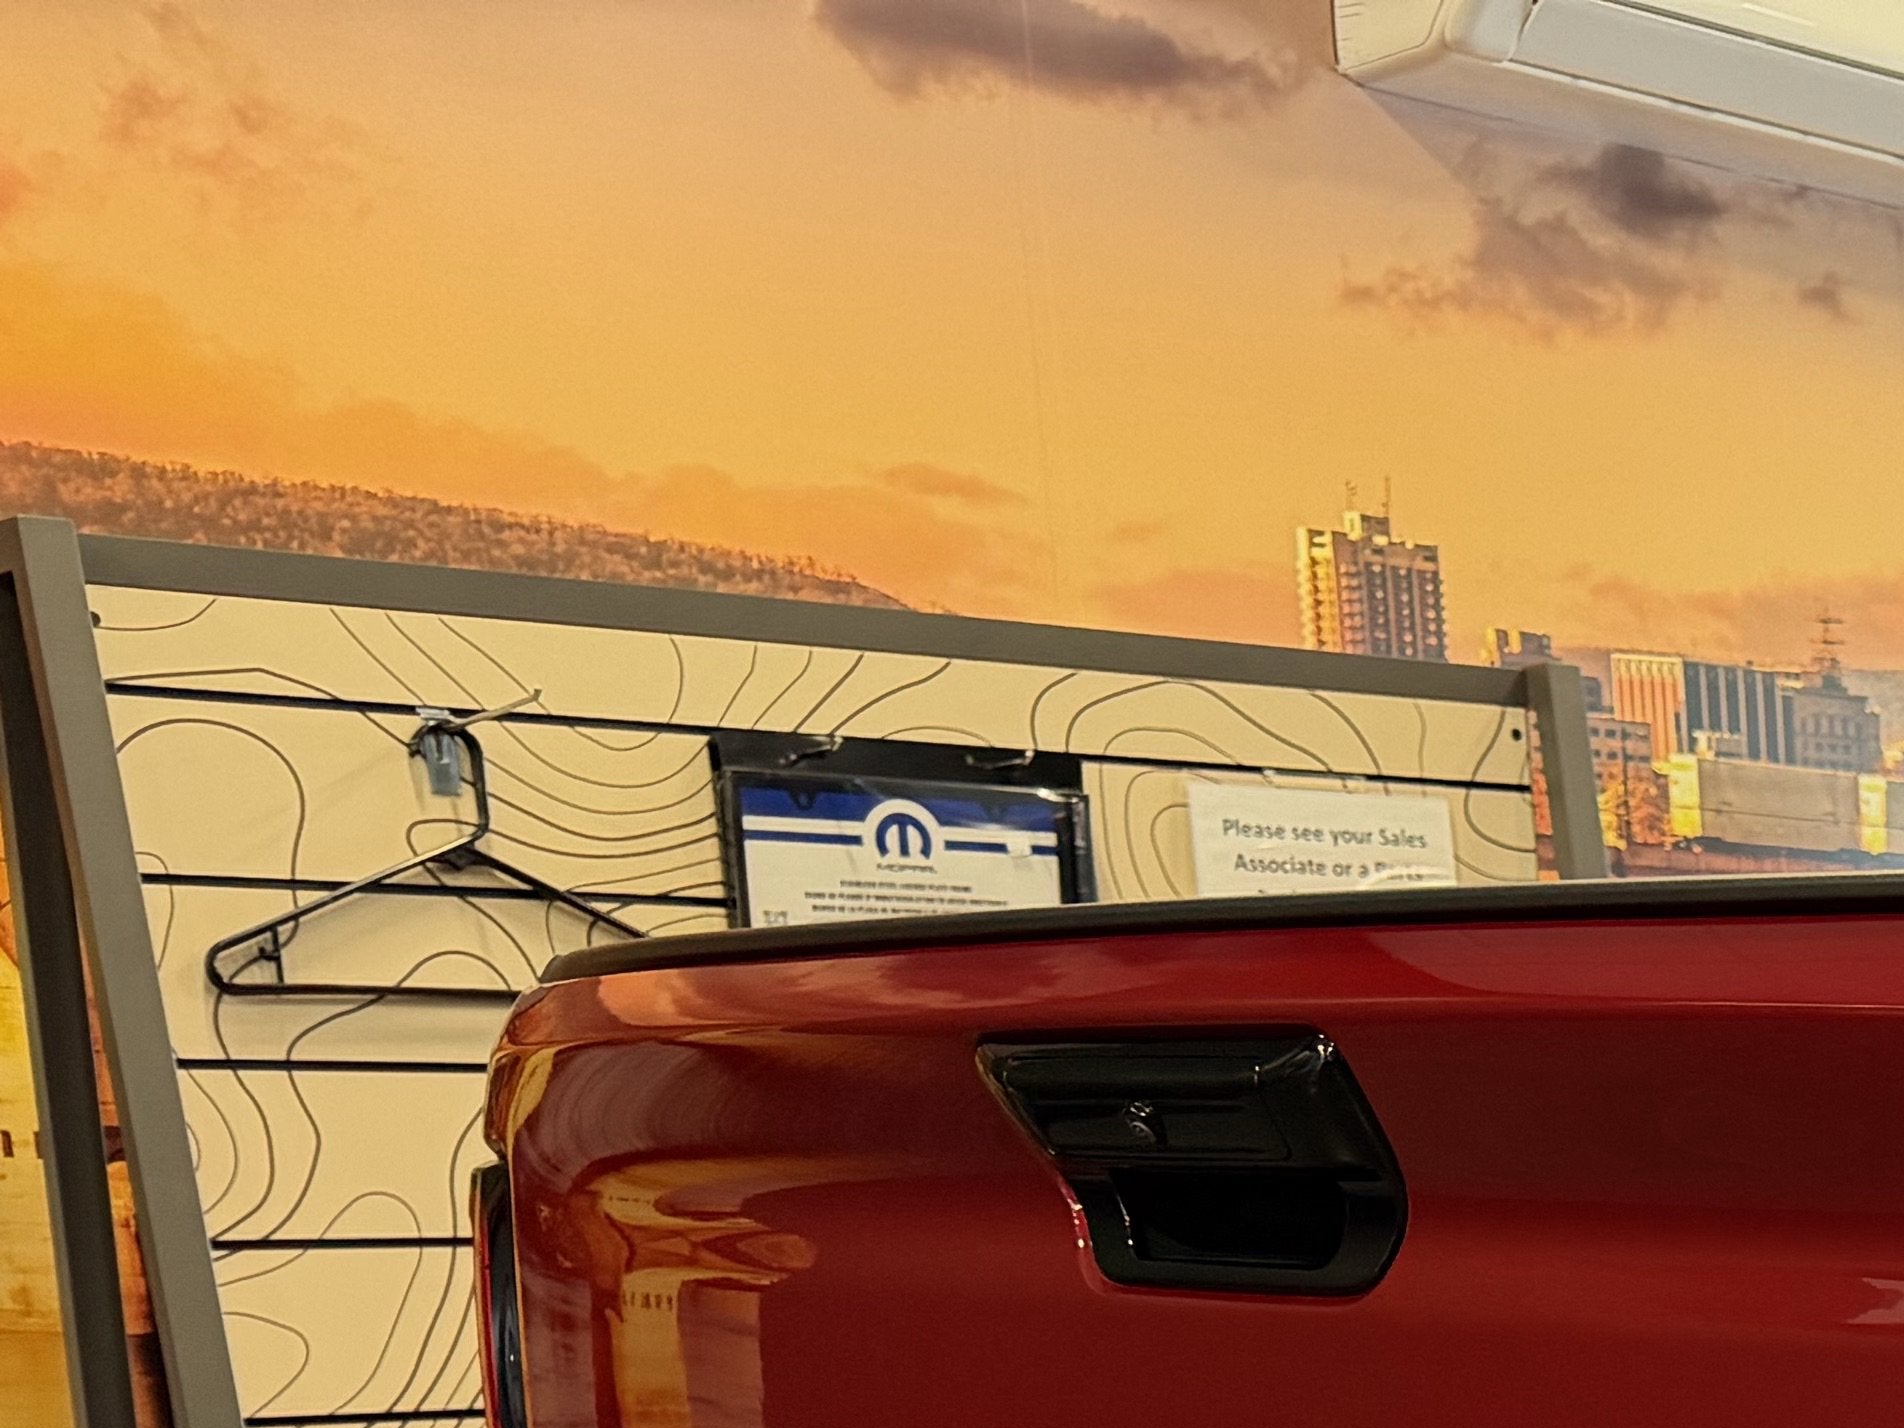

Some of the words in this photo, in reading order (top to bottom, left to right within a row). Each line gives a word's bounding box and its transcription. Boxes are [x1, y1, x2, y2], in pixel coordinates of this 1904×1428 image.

[1222, 818, 1285, 840] Please
[1291, 826, 1324, 842] see
[1330, 829, 1372, 847] your
[1378, 828, 1427, 849] Sales
[1234, 853, 1326, 877] Associate
[1332, 861, 1351, 877] or
